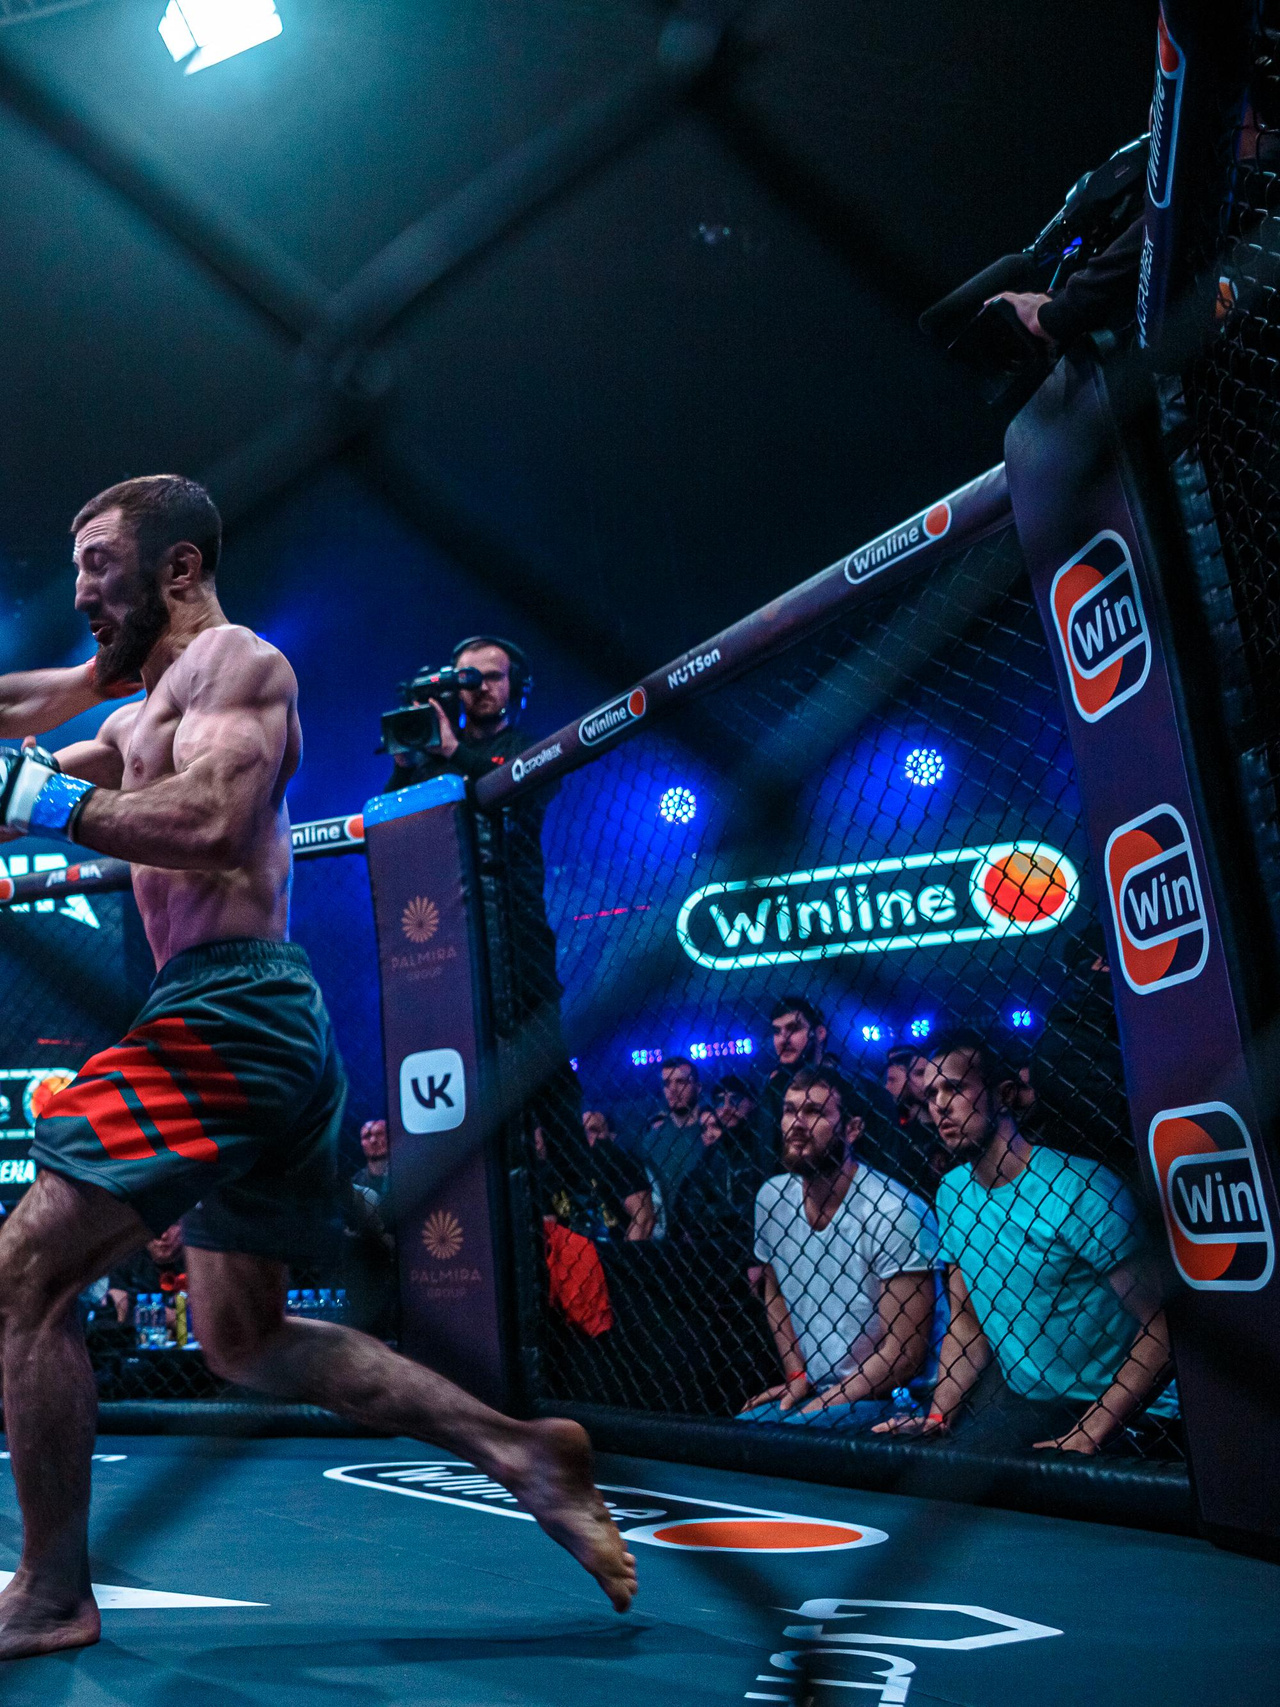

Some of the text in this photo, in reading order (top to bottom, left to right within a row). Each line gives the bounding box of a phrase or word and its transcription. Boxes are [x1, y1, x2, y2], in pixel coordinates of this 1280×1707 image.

[853, 523, 921, 576] Winline
[1074, 595, 1138, 661] Win
[584, 704, 628, 741] Winline
[292, 825, 341, 846] nline
[45, 860, 102, 888] ARENA
[709, 883, 957, 948] Winline
[1127, 871, 1197, 931] Win
[410, 1073, 454, 1110] VK
[1176, 1172, 1259, 1224] Win
